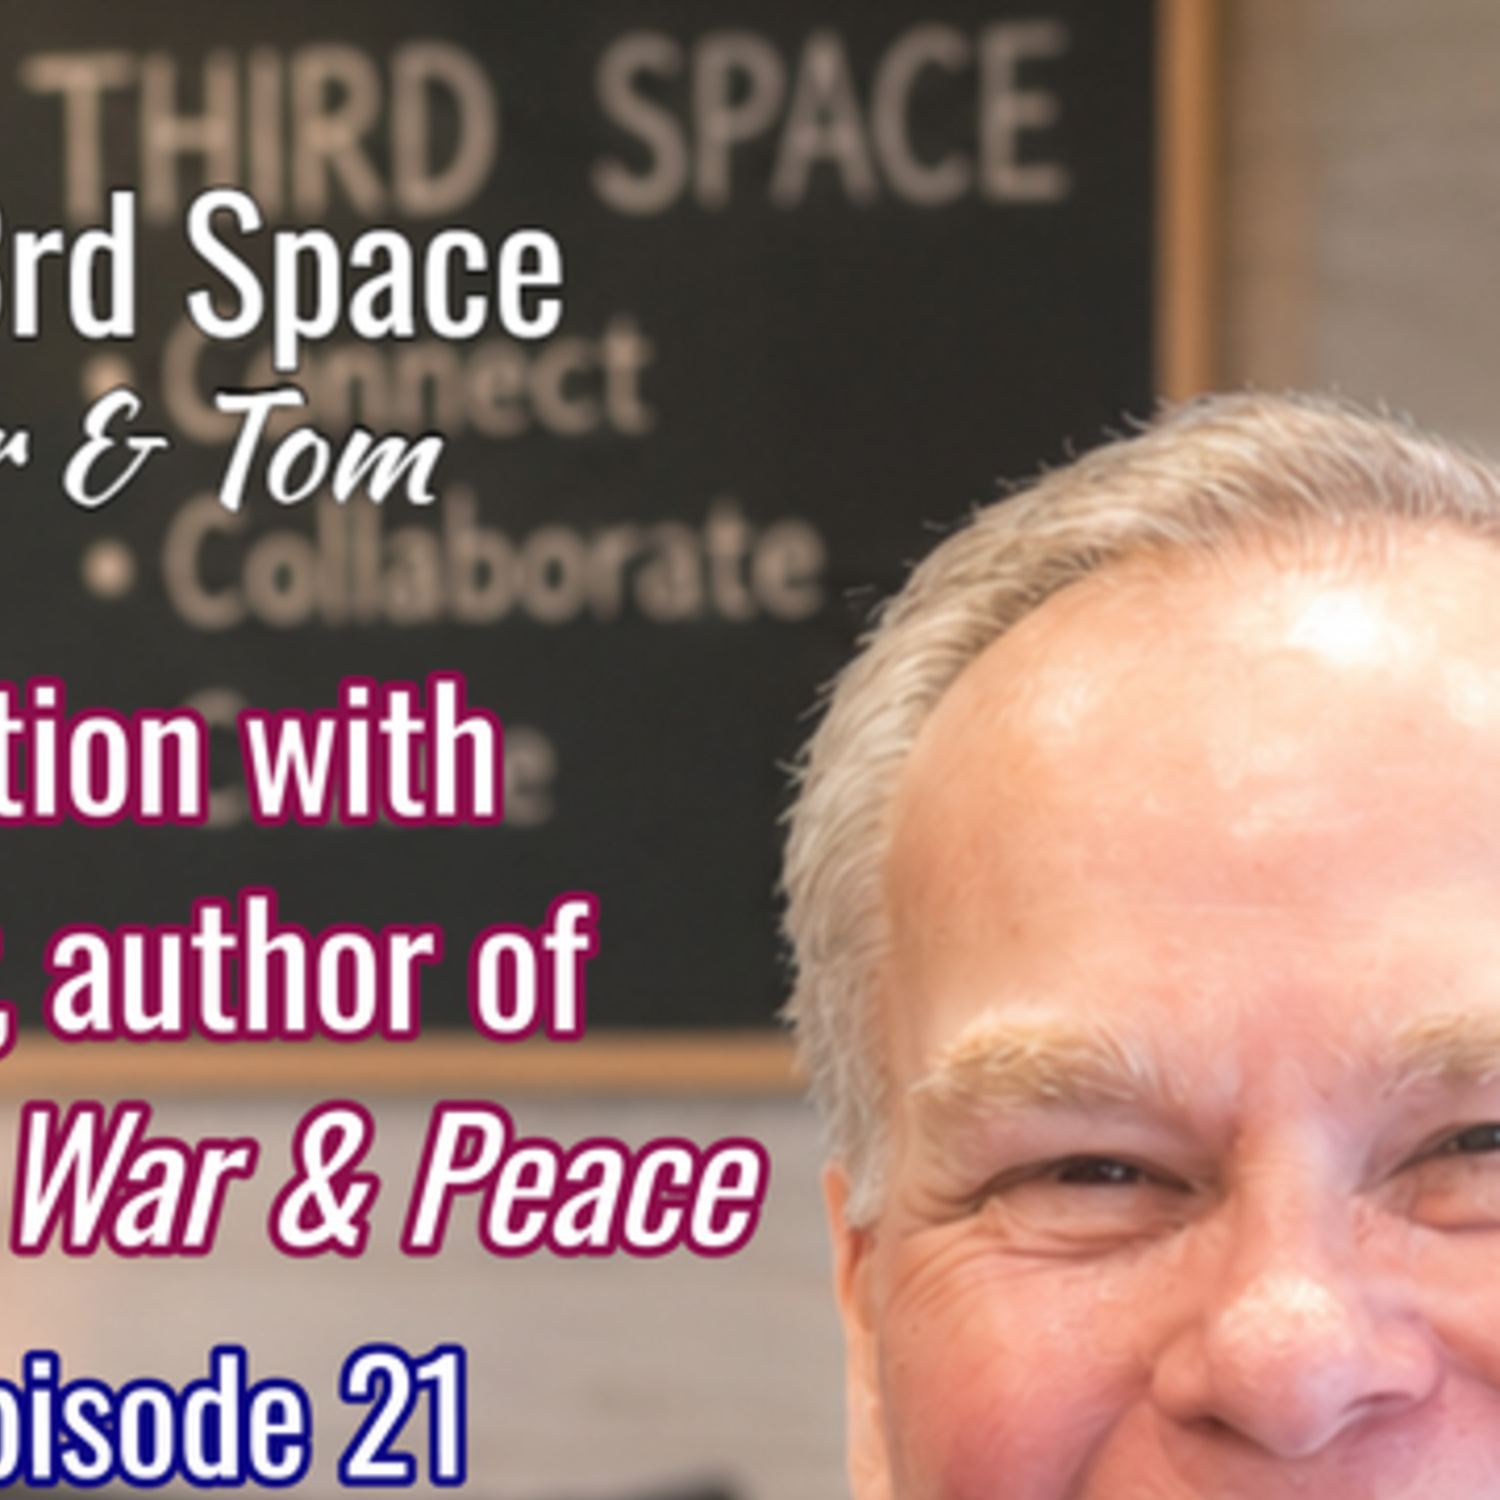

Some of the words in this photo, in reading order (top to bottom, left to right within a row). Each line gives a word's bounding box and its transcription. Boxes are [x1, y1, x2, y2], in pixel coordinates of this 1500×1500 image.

[20, 44, 498, 222] THIRD
[592, 22, 1070, 210] SPACE
[162, 492, 825, 627] Collaborate
